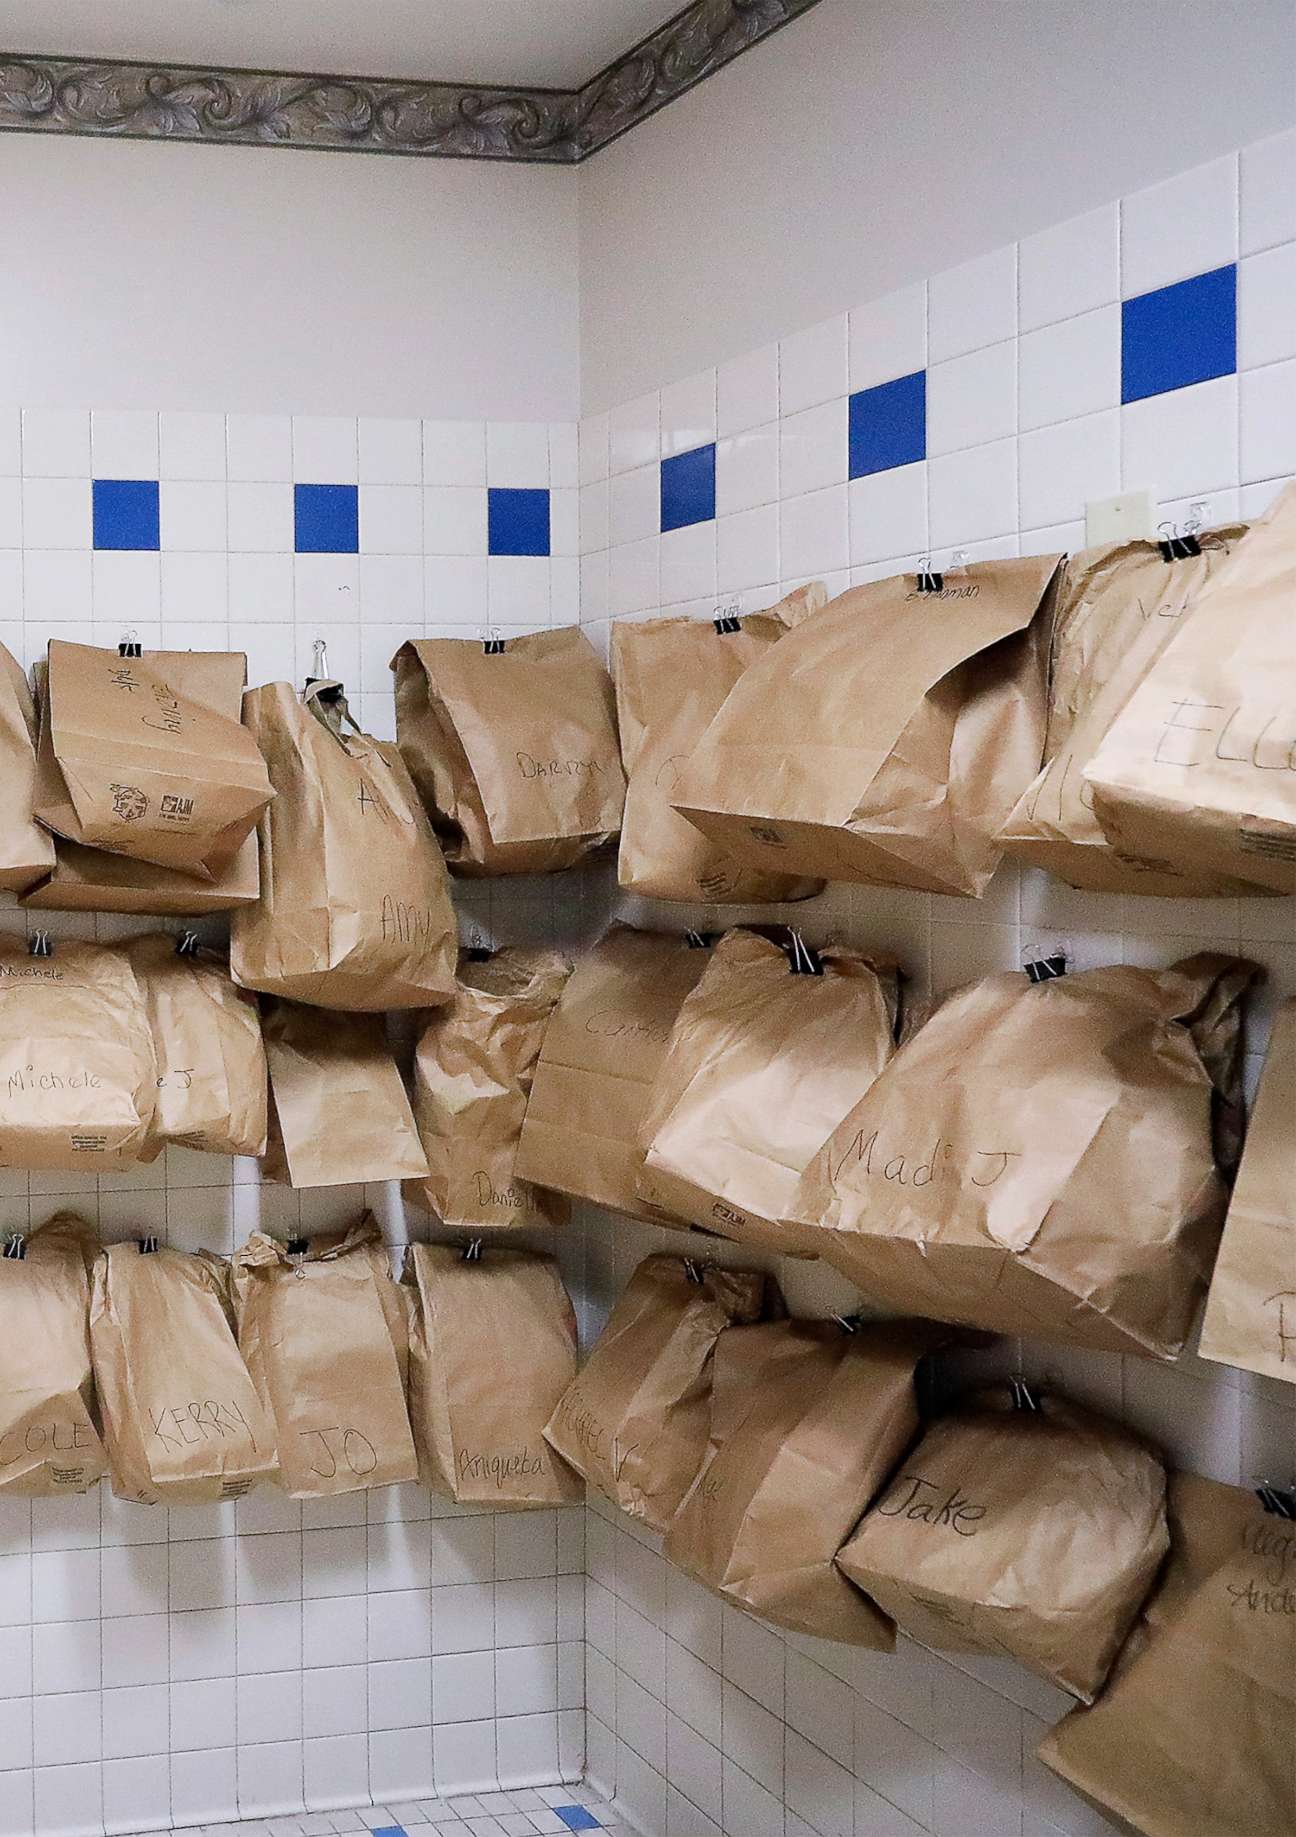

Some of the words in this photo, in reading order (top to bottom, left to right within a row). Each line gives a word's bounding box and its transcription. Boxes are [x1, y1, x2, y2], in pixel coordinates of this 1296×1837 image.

[381, 894, 432, 945] Amy
[7, 1063, 102, 1101] Michele
[971, 1151, 1023, 1188] J
[148, 1399, 257, 1454] KERRY
[298, 1425, 378, 1479] JO
[877, 1475, 987, 1537] Jake
